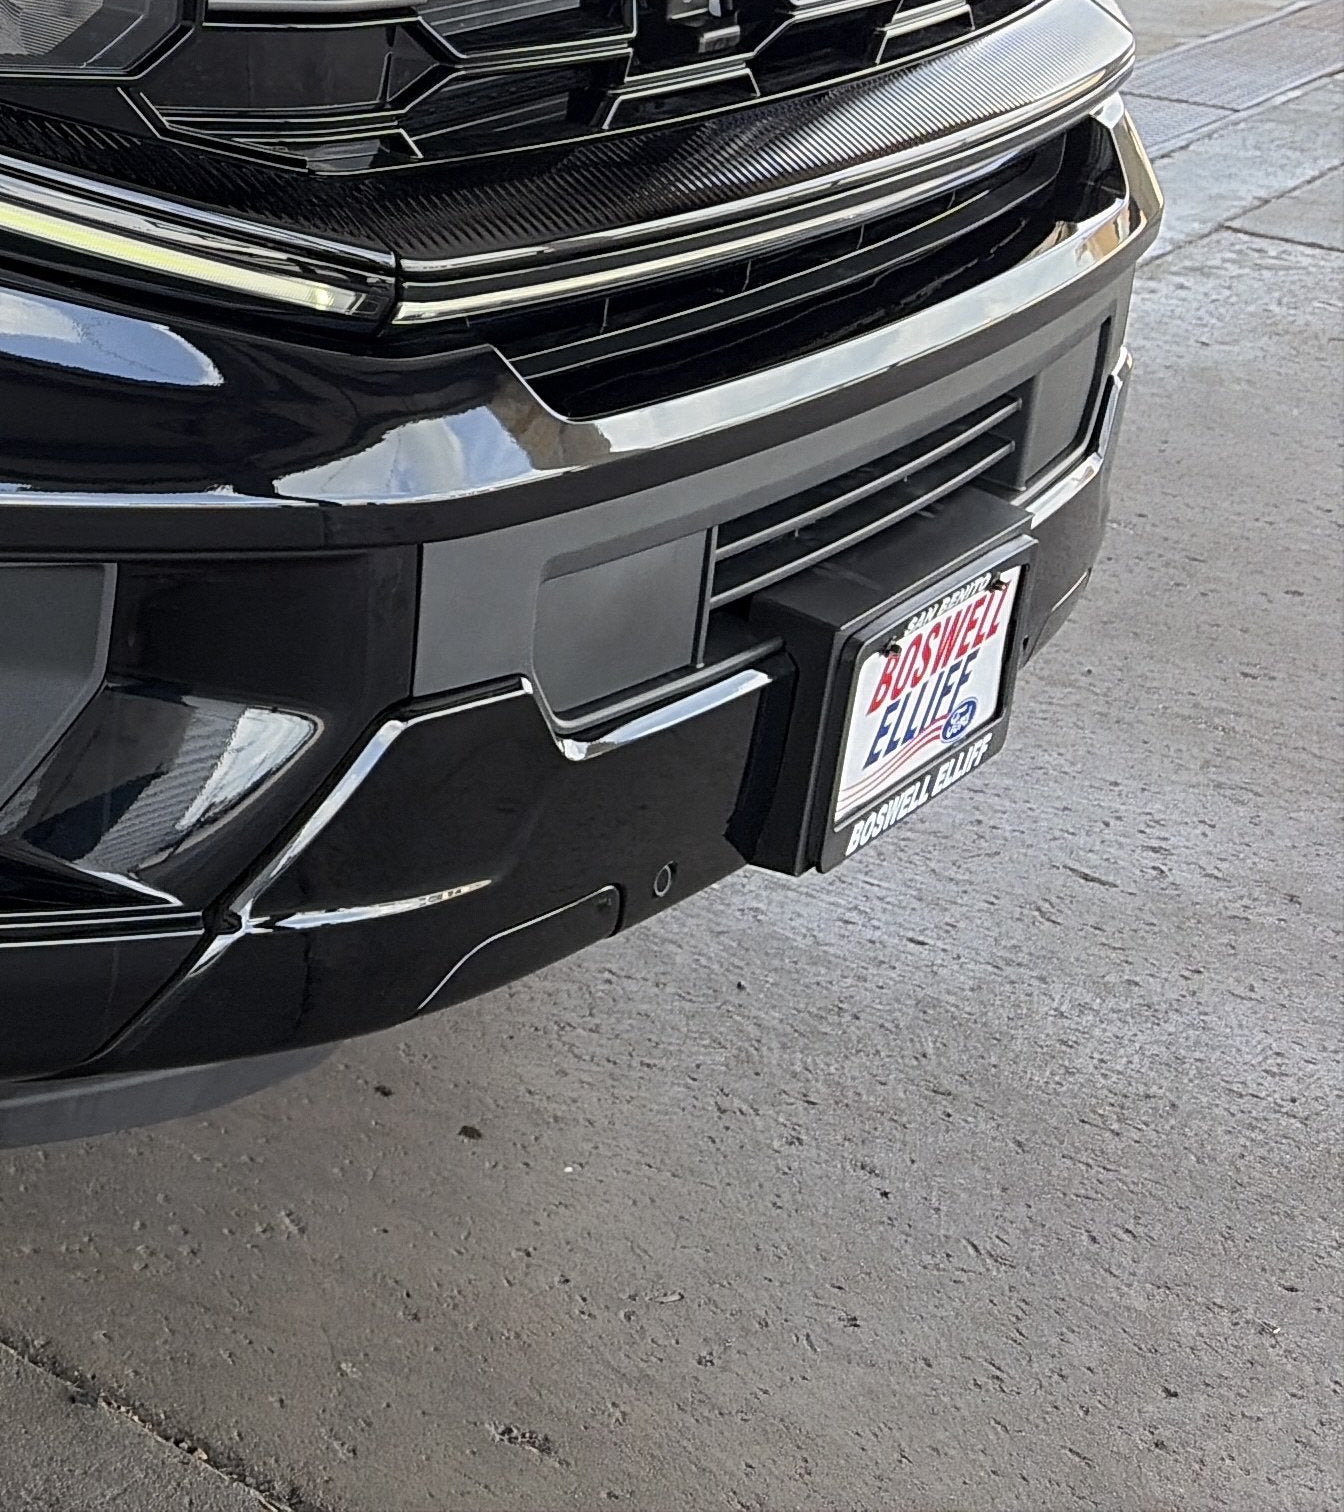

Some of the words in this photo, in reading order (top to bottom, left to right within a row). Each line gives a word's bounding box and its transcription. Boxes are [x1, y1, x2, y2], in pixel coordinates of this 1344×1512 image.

[865, 580, 1011, 717] BOSWELL
[904, 602, 940, 637] SAN
[861, 647, 981, 771] ELLIFF
[845, 782, 931, 857] BOSWELL
[931, 732, 993, 798] ELLIFF
